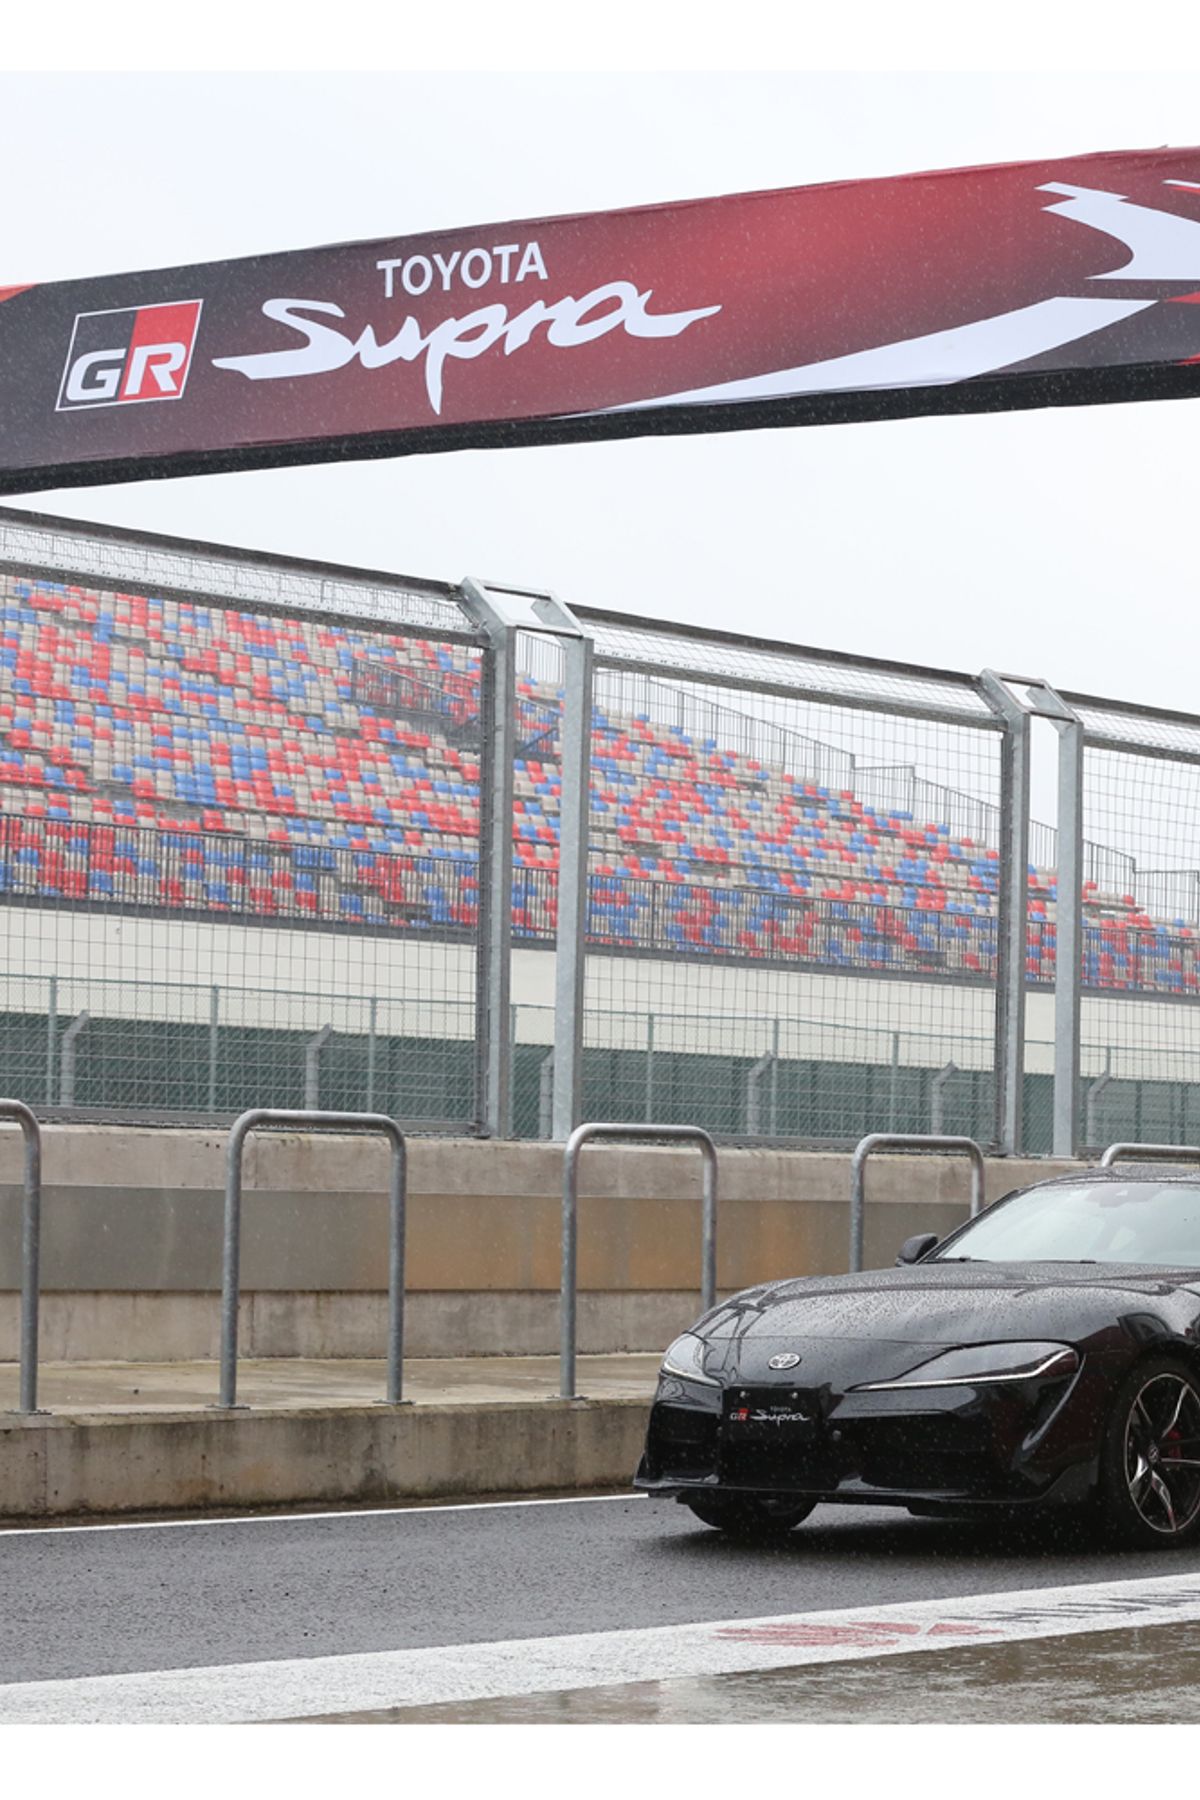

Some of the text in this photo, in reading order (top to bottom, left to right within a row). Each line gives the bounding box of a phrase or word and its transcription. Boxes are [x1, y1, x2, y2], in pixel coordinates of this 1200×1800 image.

[377, 242, 548, 298] TOYOTA
[66, 281, 722, 415] GR Supra
[750, 1408, 810, 1427] Supra
